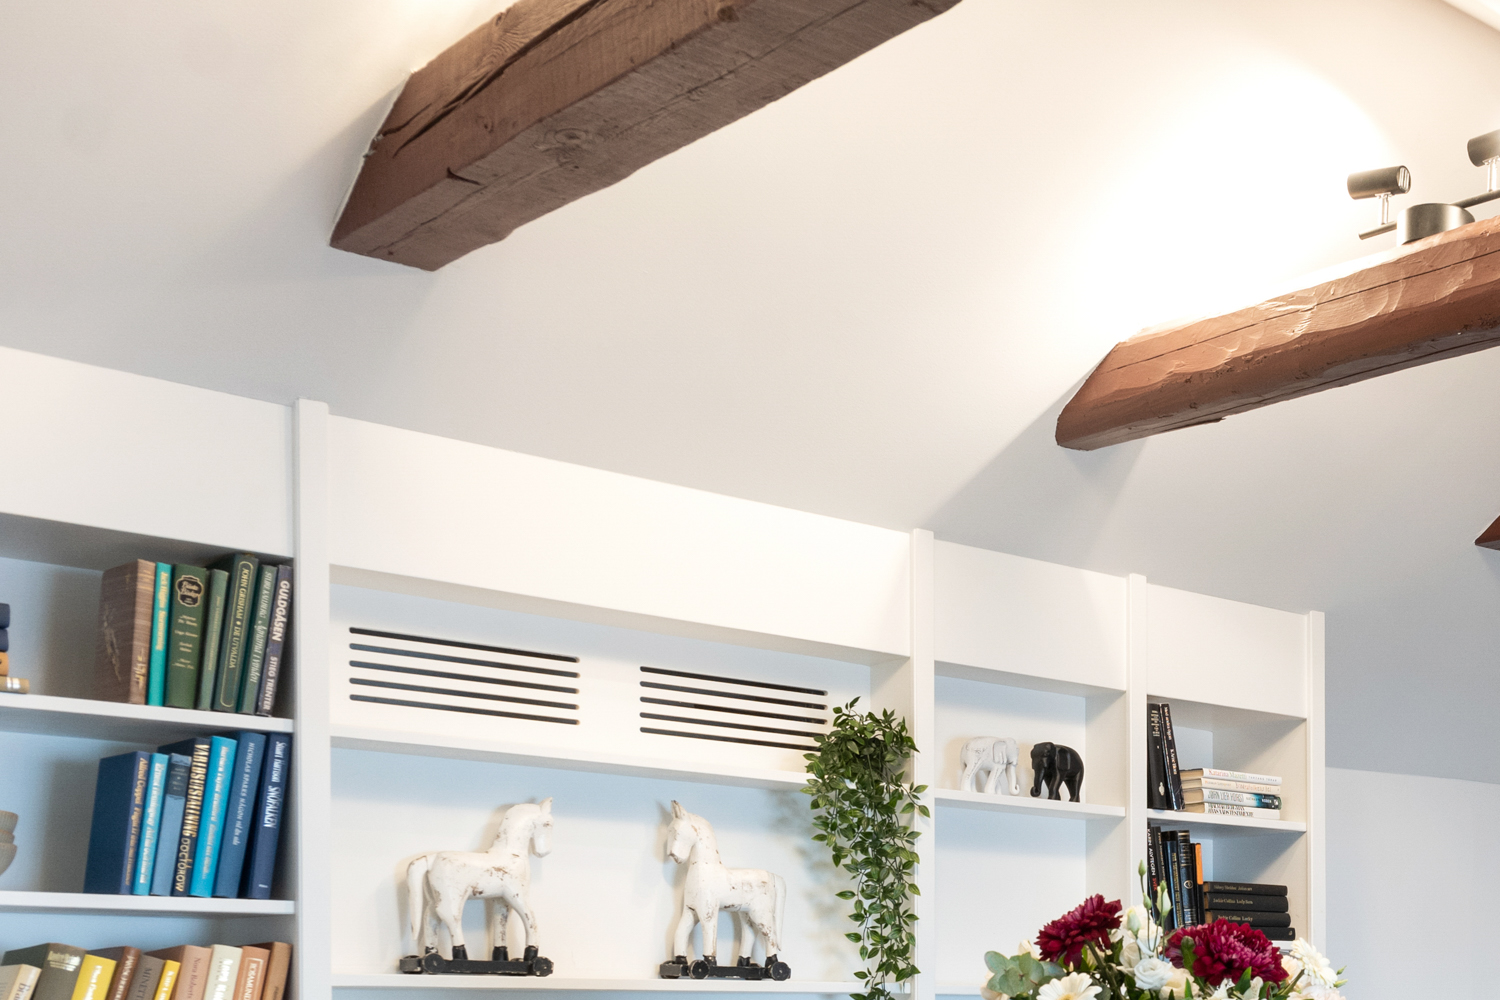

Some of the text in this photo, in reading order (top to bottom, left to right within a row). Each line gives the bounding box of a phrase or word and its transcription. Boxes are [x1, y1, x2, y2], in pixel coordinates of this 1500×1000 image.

[229, 568, 250, 668] JOHN GRISHAM DE UTVALDA
[273, 581, 290, 641] GULDGÅSEN
[264, 657, 278, 710] STIEG TRENTER
[241, 743, 255, 796] NICHOLAS SPARKS
[272, 742, 285, 782] Stuart Harrison
[1208, 769, 1229, 777] Katarina
[237, 798, 246, 820] NÅGON
[264, 786, 281, 827] SNÖFALKEN
[188, 958, 201, 998] Nora Roberts
